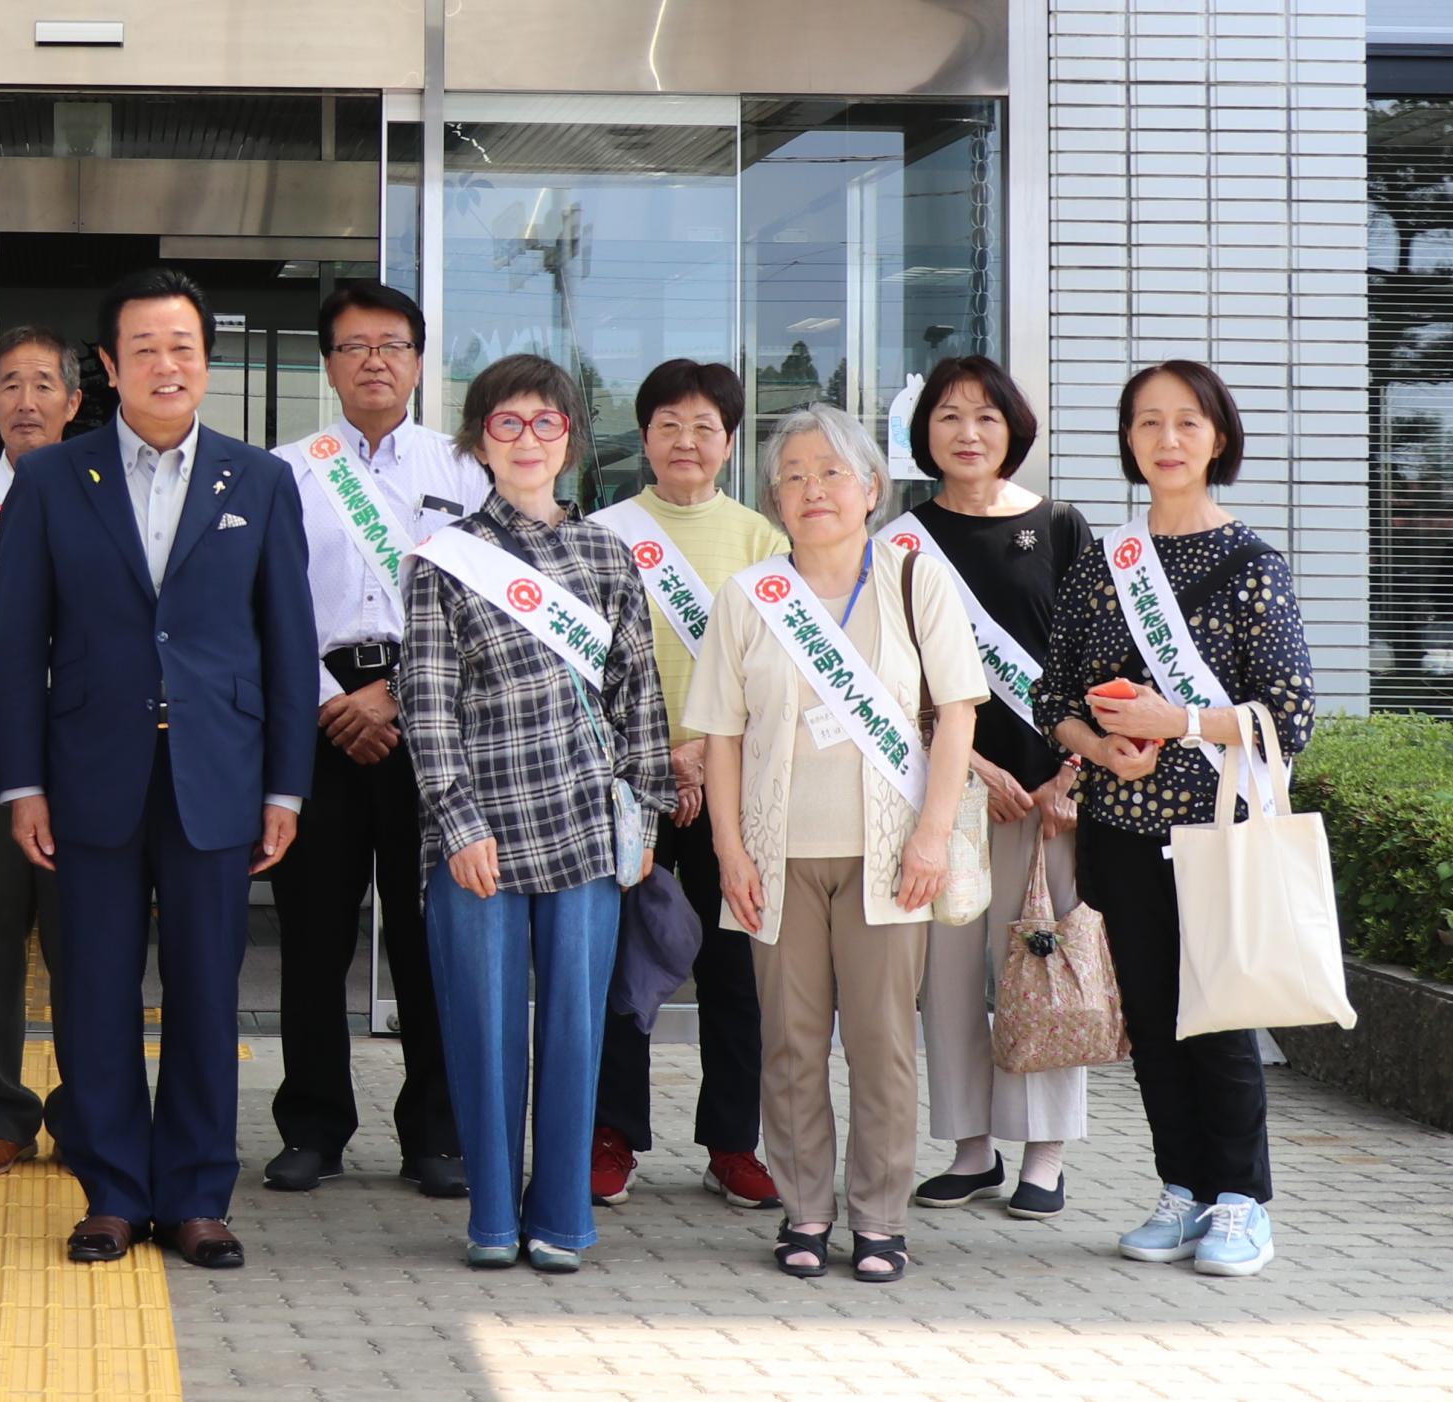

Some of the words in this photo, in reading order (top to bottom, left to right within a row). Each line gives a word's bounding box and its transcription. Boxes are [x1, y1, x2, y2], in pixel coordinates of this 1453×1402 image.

[327, 457, 404, 587] “社会を明るくす
